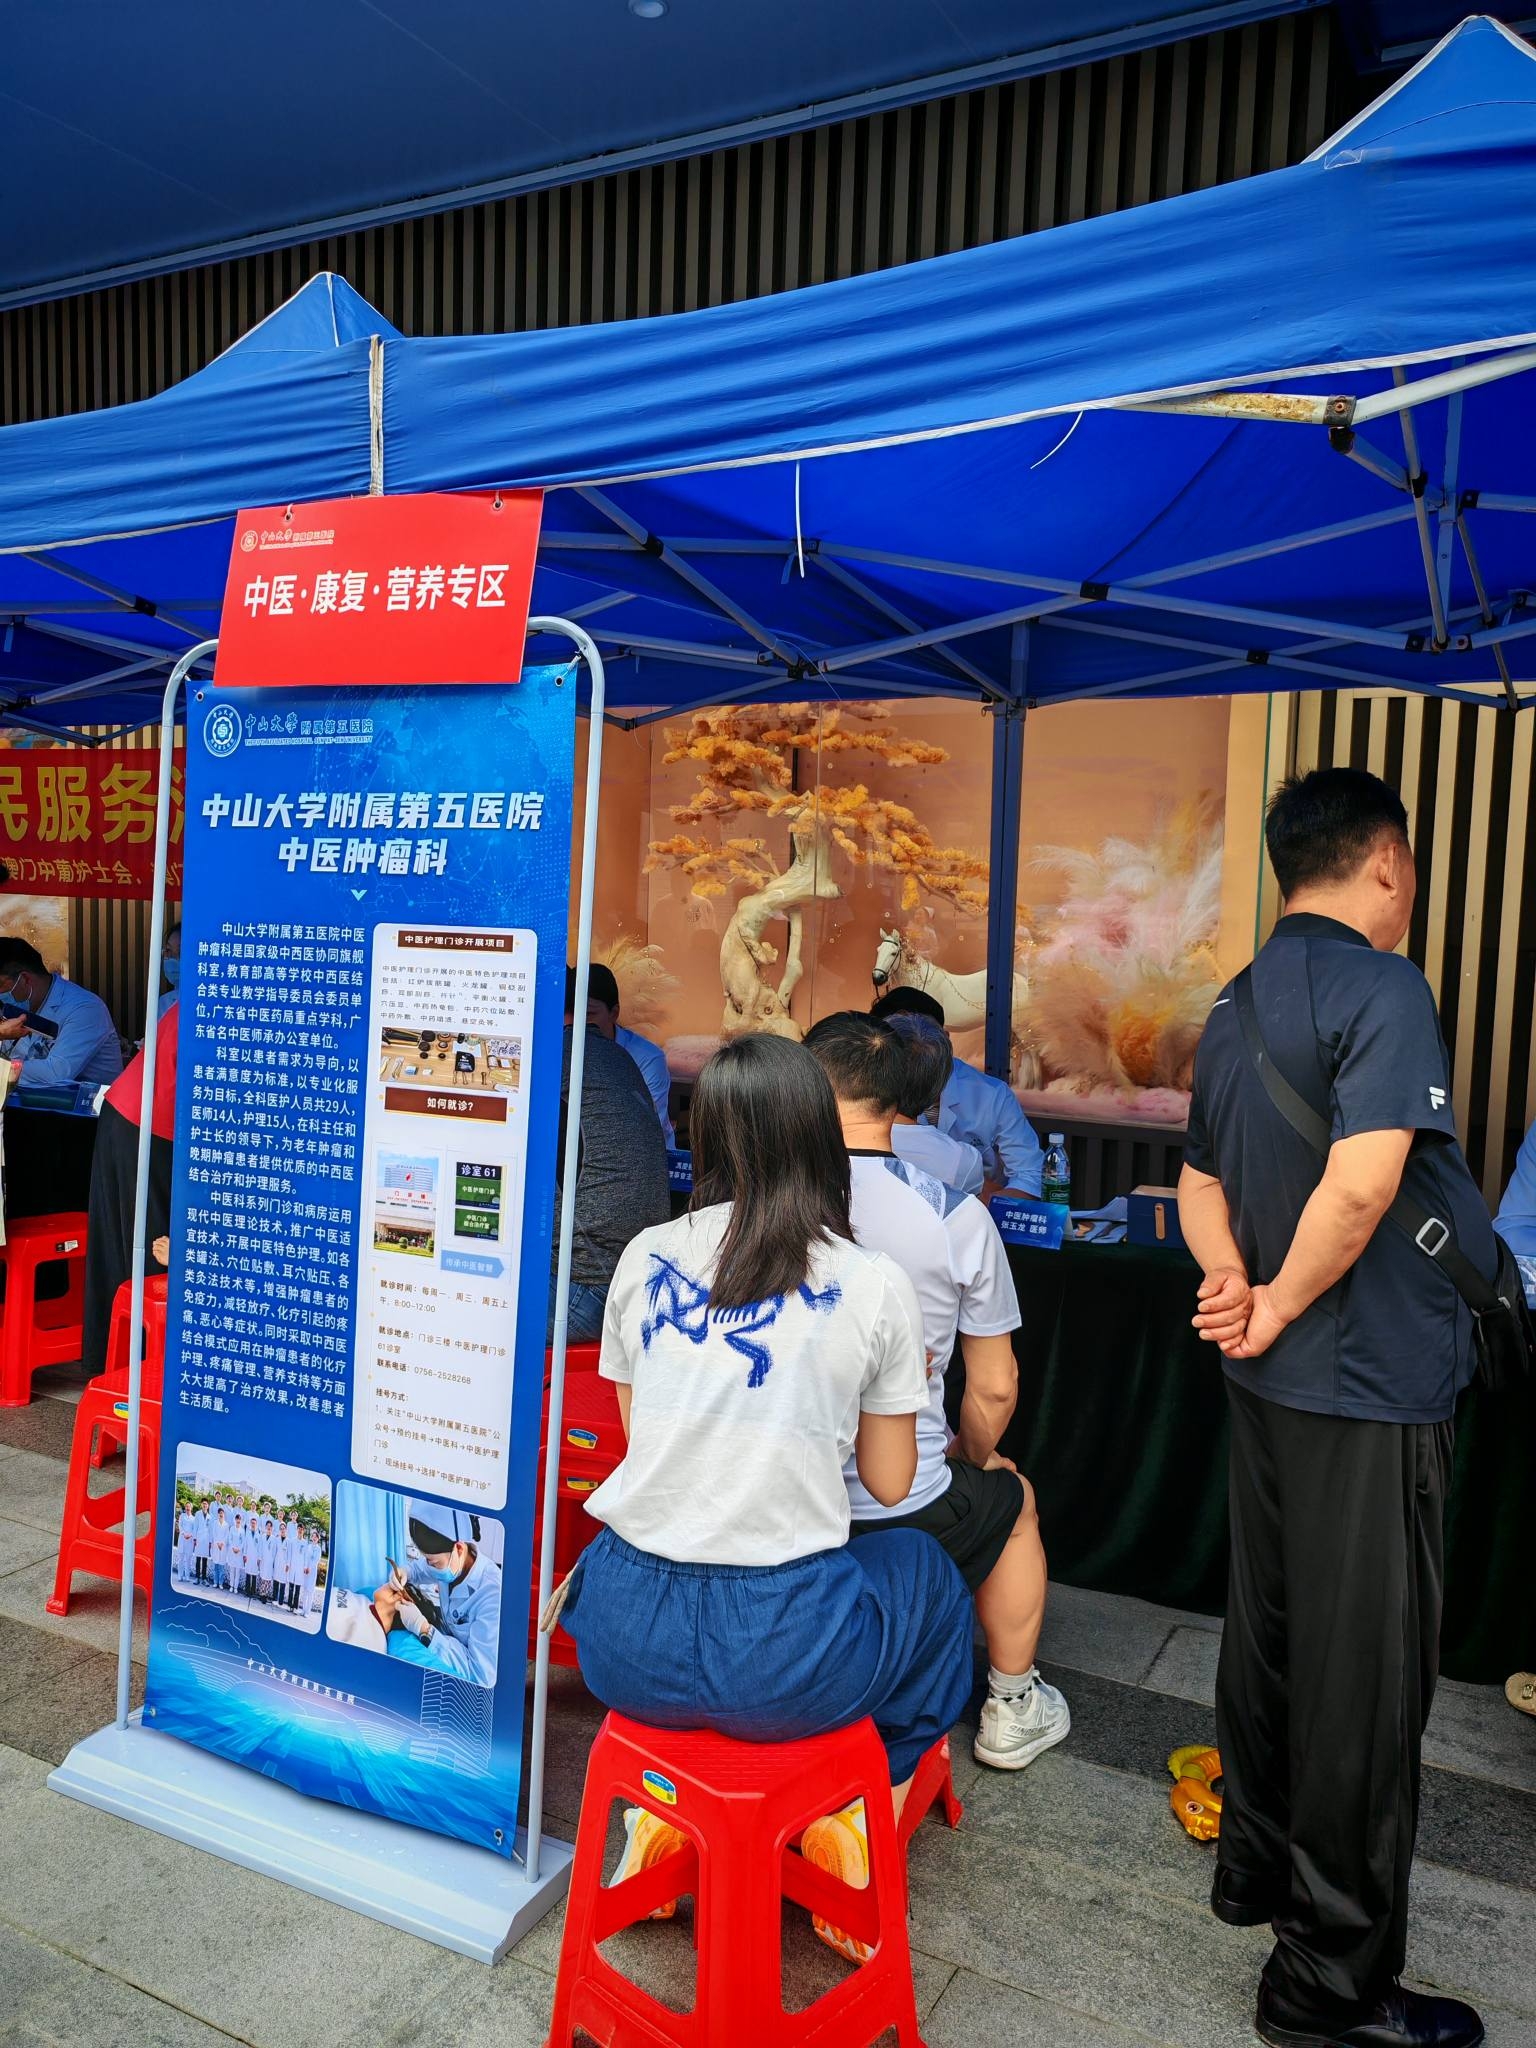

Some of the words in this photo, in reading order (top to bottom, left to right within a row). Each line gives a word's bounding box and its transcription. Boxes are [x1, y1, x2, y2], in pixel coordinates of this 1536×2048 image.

[201, 791, 545, 832] 中山大学附属第五医院
[278, 837, 448, 876] 中医肿瘤科
[222, 922, 365, 942] 中山大学附属第五医院中医
[404, 934, 505, 948] 中医护理门诊开展项目
[198, 942, 364, 964] 肿瘤科是国家级中西医协同旗舰
[196, 983, 362, 1007] 合类专业教学指导委员会委员单
[190, 1147, 354, 1181] 晚期肿瘤患者提供优质的中西医
[461, 1164, 482, 1177] 诊室
[484, 1168, 496, 1178] 61
[210, 1191, 352, 1224] 中医科系列门诊和病房运用
[1029, 1224, 1047, 1235] 医师
[182, 1329, 346, 1376] 结合模式应用在肿瘤患者的化疗
[374, 1439, 390, 1449] 门诊
